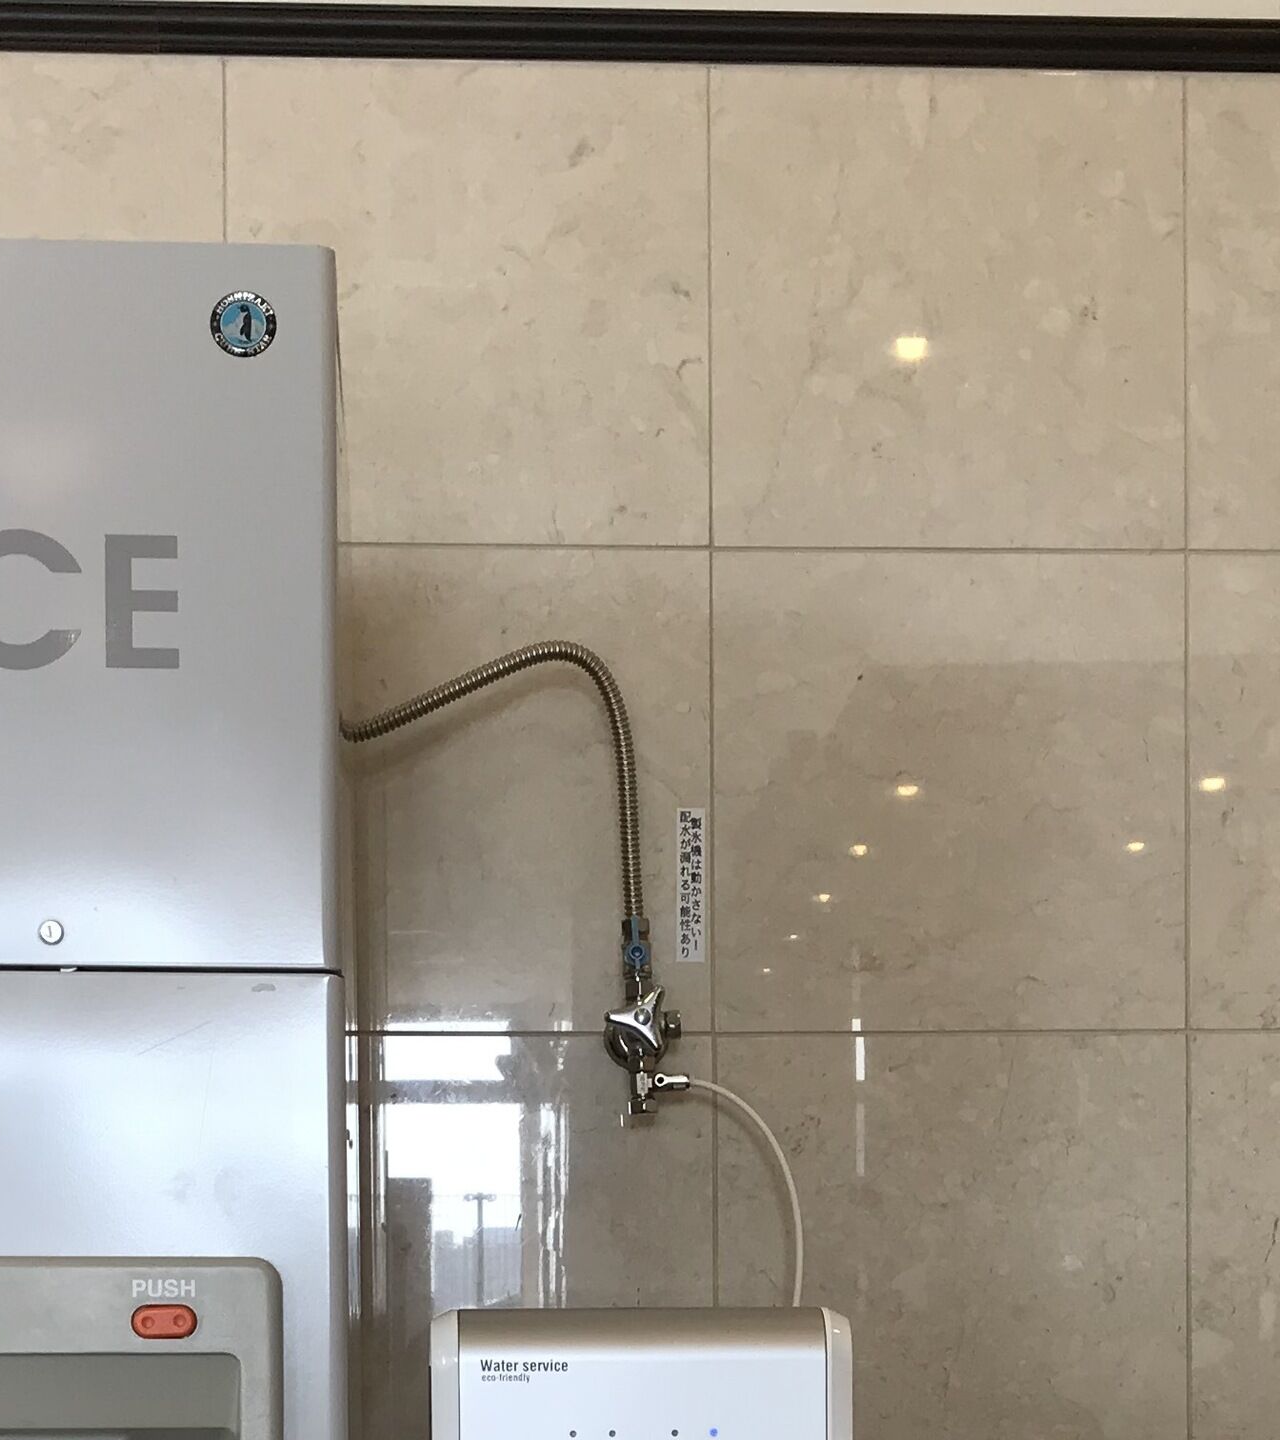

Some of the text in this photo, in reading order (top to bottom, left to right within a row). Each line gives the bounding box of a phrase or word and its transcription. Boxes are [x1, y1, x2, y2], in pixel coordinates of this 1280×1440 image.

[131, 1279, 196, 1298] PUSH
[480, 1359, 568, 1372] Water service
